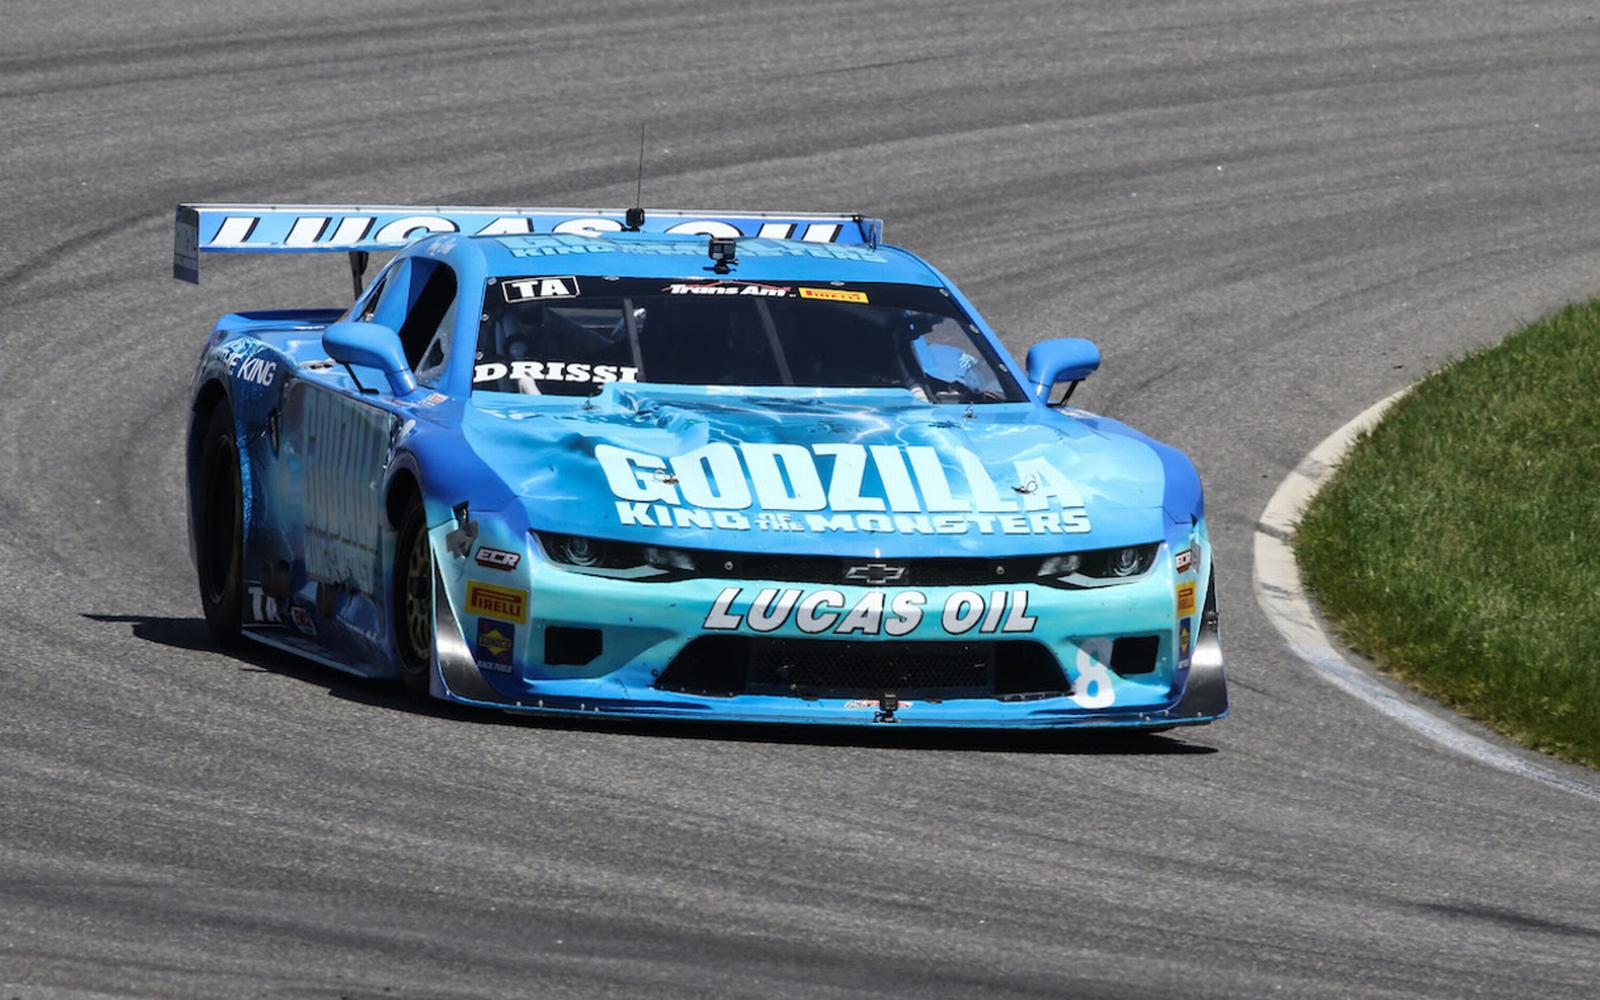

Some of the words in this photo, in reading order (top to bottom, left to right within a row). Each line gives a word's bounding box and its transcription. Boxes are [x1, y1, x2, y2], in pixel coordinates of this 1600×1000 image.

[512, 279, 568, 297] TA
[669, 284, 739, 295] Trans
[740, 286, 786, 296] Am
[237, 356, 277, 386] KING
[473, 362, 638, 383] DRISSI
[594, 443, 1085, 513] GODZILLA
[617, 501, 752, 531] KING
[804, 512, 1092, 535] MONSTERS
[477, 548, 519, 566] ECR
[471, 587, 522, 617] PIRELLI
[703, 588, 926, 636] LUCAS
[941, 589, 1039, 633] OIL
[1075, 638, 1115, 709] 8
